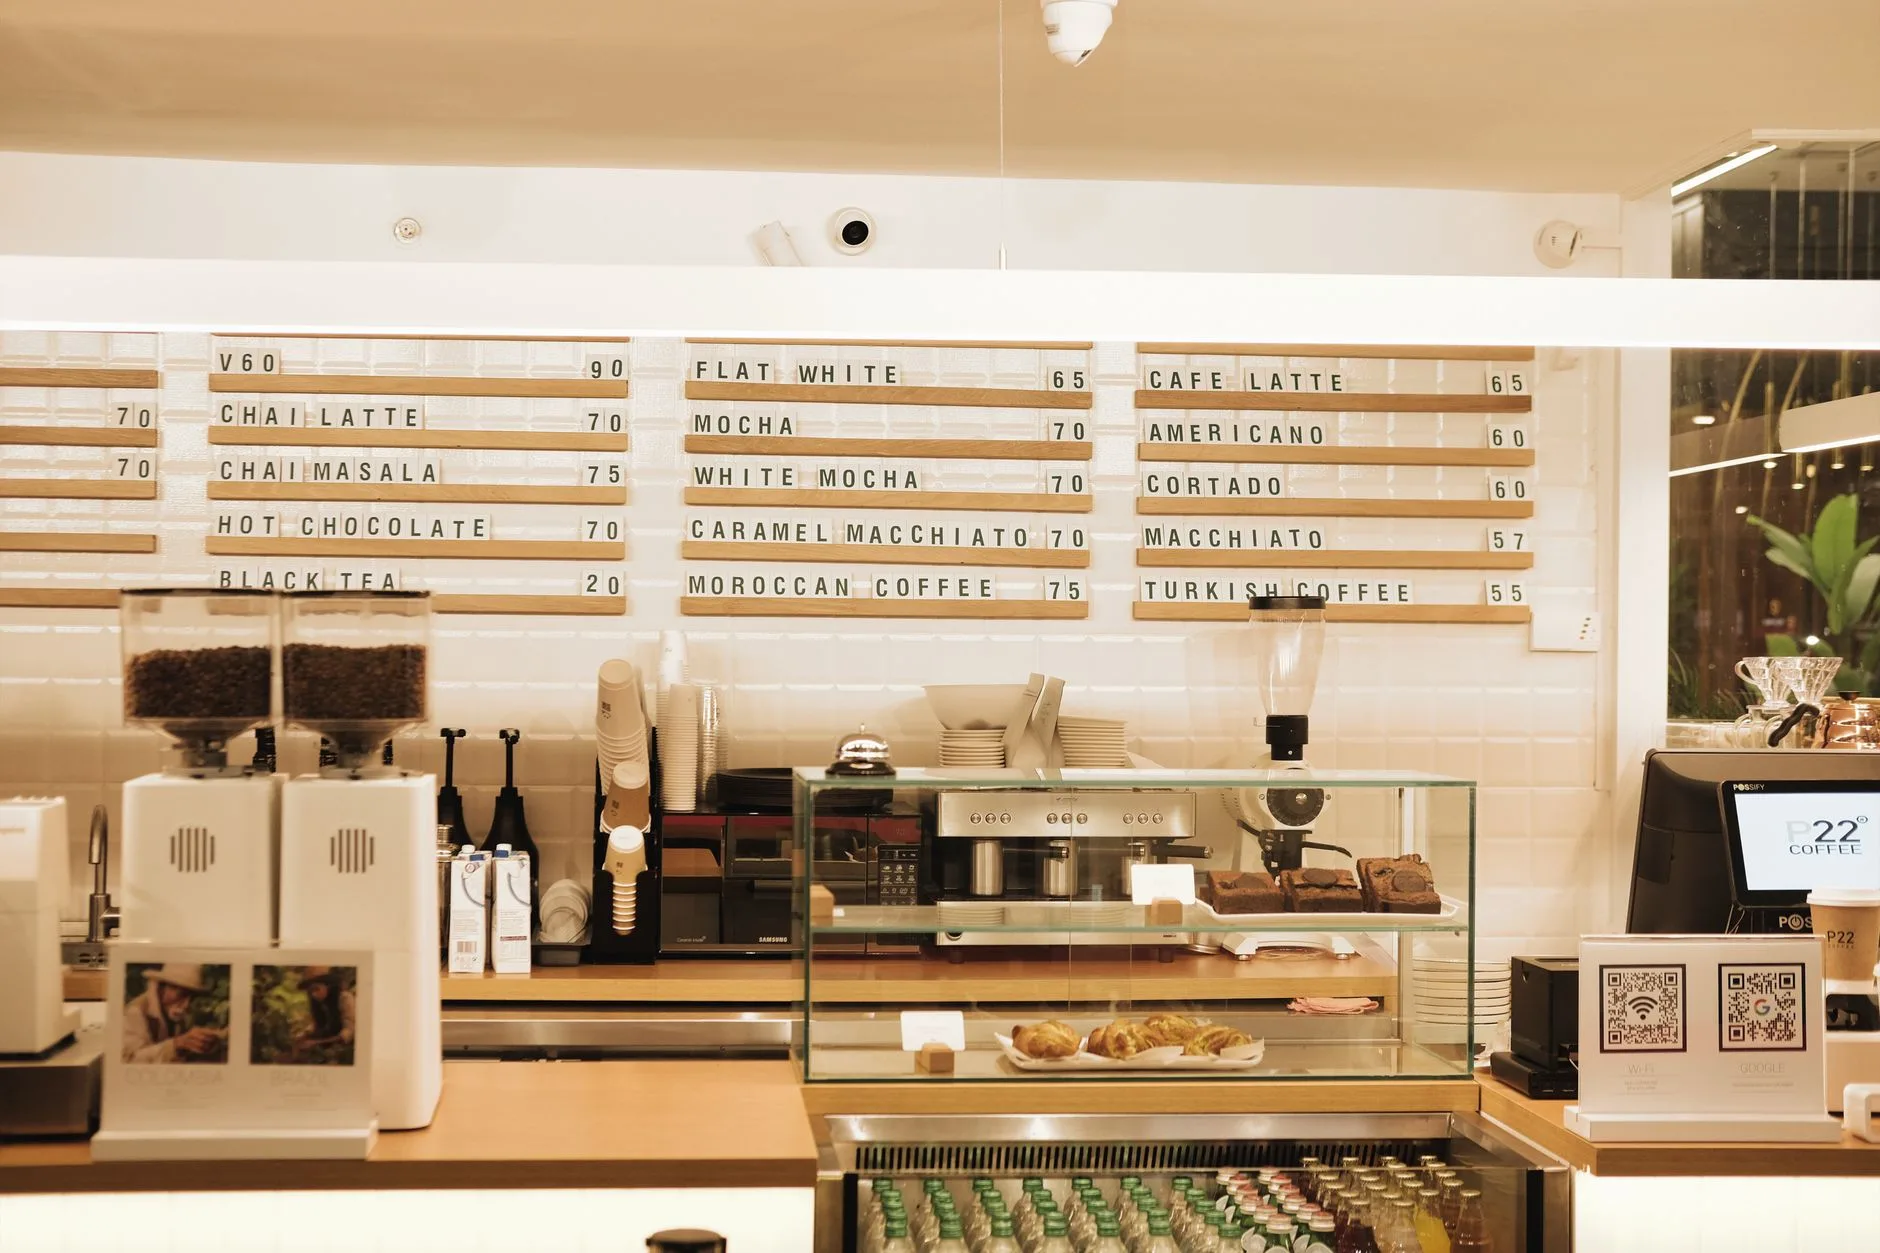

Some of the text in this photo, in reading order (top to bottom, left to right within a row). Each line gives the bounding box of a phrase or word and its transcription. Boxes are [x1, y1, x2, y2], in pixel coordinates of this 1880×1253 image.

[219, 353, 623, 379] V60 90
[696, 361, 1084, 389] FLAT WHITE 65
[1150, 370, 1523, 393] CAFE LATTE 65
[117, 407, 150, 428] 70
[221, 404, 621, 433] CHAI LATTE 70
[694, 414, 1085, 441] MOCHA 70
[1149, 423, 1524, 448] AMERICANO 60
[117, 458, 150, 479] 70
[220, 460, 620, 484] CHAI MASALA 75
[694, 466, 1083, 494] WHITE MOCHA 70
[1147, 474, 1525, 499] CORTADO 60
[218, 515, 618, 540] HOT CHOCOLATE 70
[691, 519, 1084, 548] CARAMEL MACCHIATO 70
[1144, 527, 1524, 551] MACCHIATO 57
[220, 571, 619, 595] BLACK TEA 20
[688, 575, 1080, 600] MOROCCAN COFFEE 75
[1145, 581, 1522, 602] TURKISH COFFEE 55
[1789, 844, 1863, 855] COFFEE
[1827, 930, 1855, 944] P22
